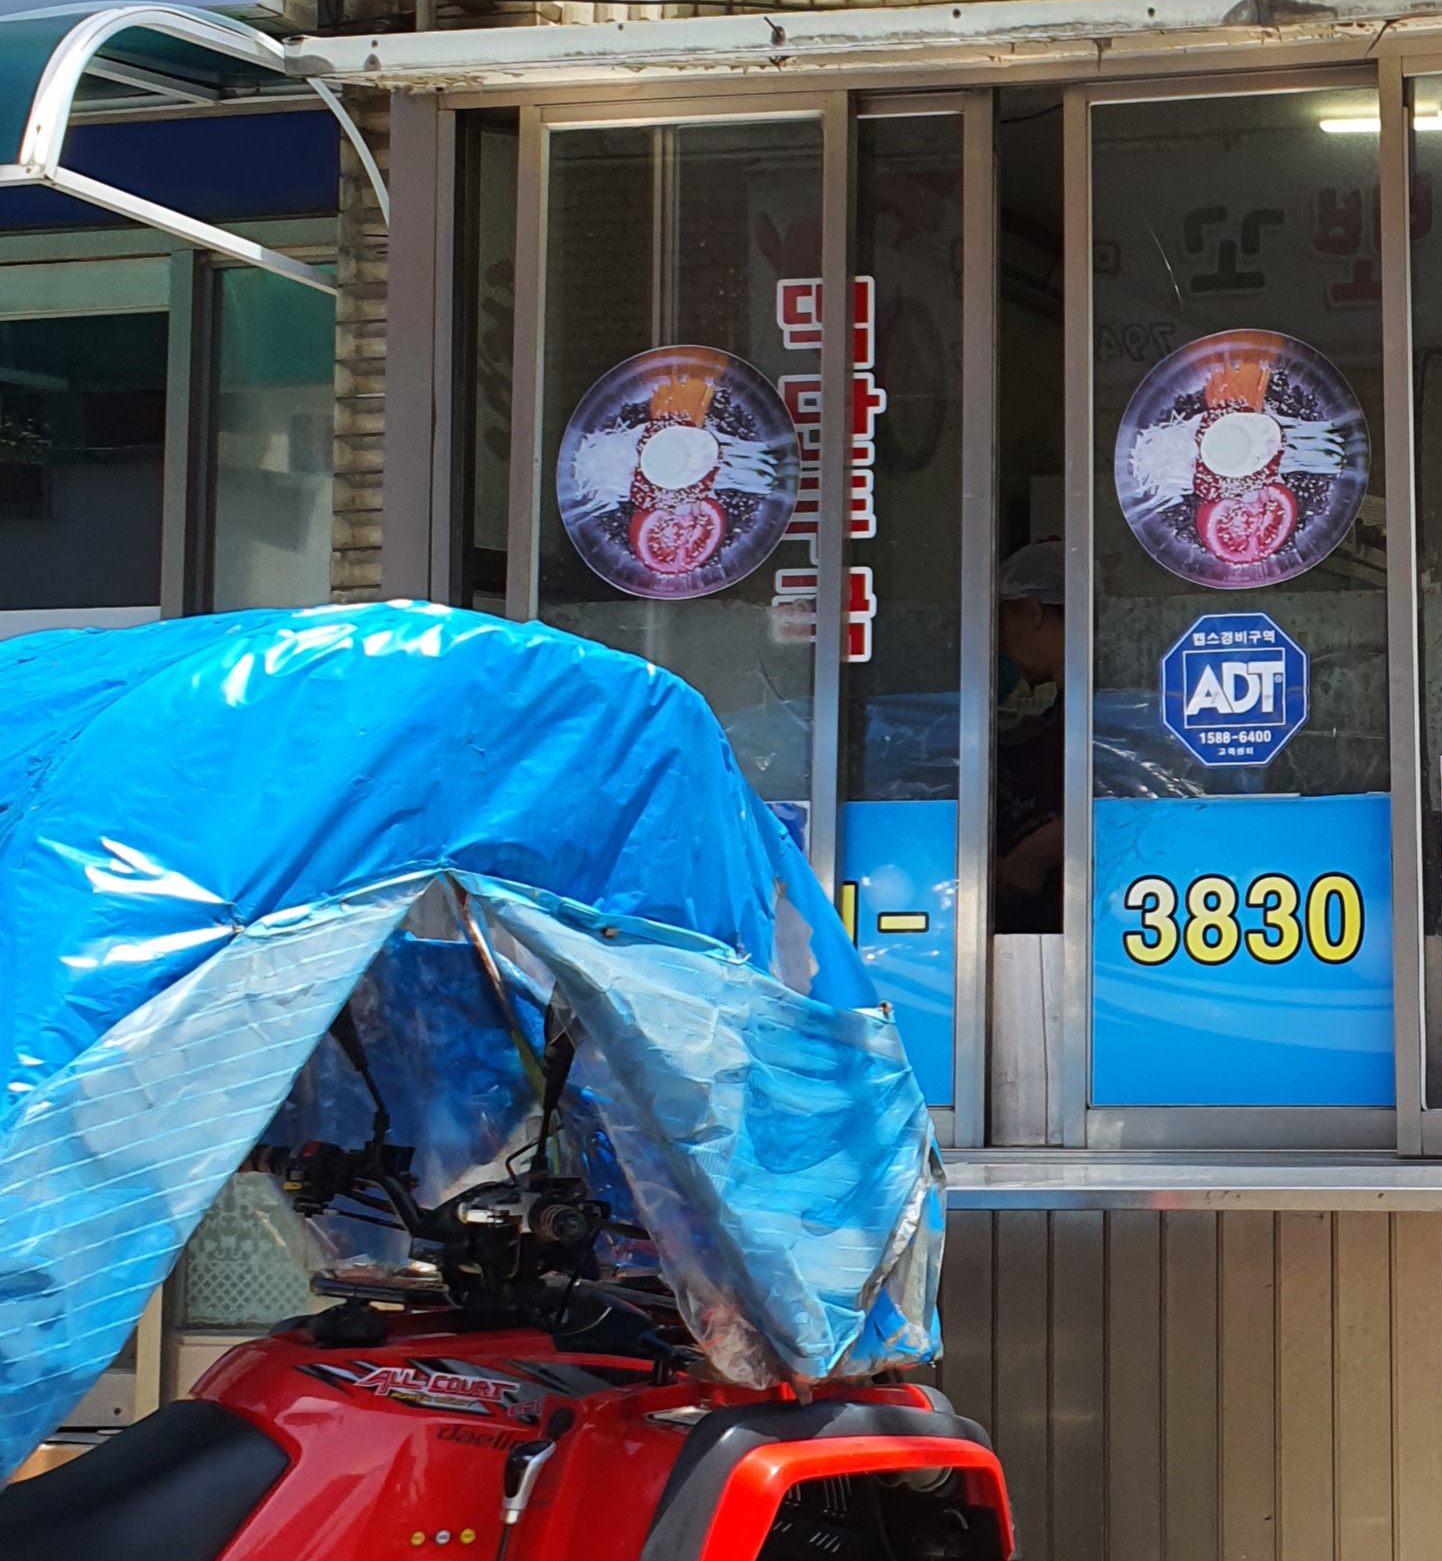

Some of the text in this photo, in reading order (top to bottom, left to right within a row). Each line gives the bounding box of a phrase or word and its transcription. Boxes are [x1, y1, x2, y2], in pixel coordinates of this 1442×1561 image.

[1186, 661, 1284, 715] ADT
[1199, 730, 1272, 744] 1588-6400
[1123, 871, 1366, 966] 3830
